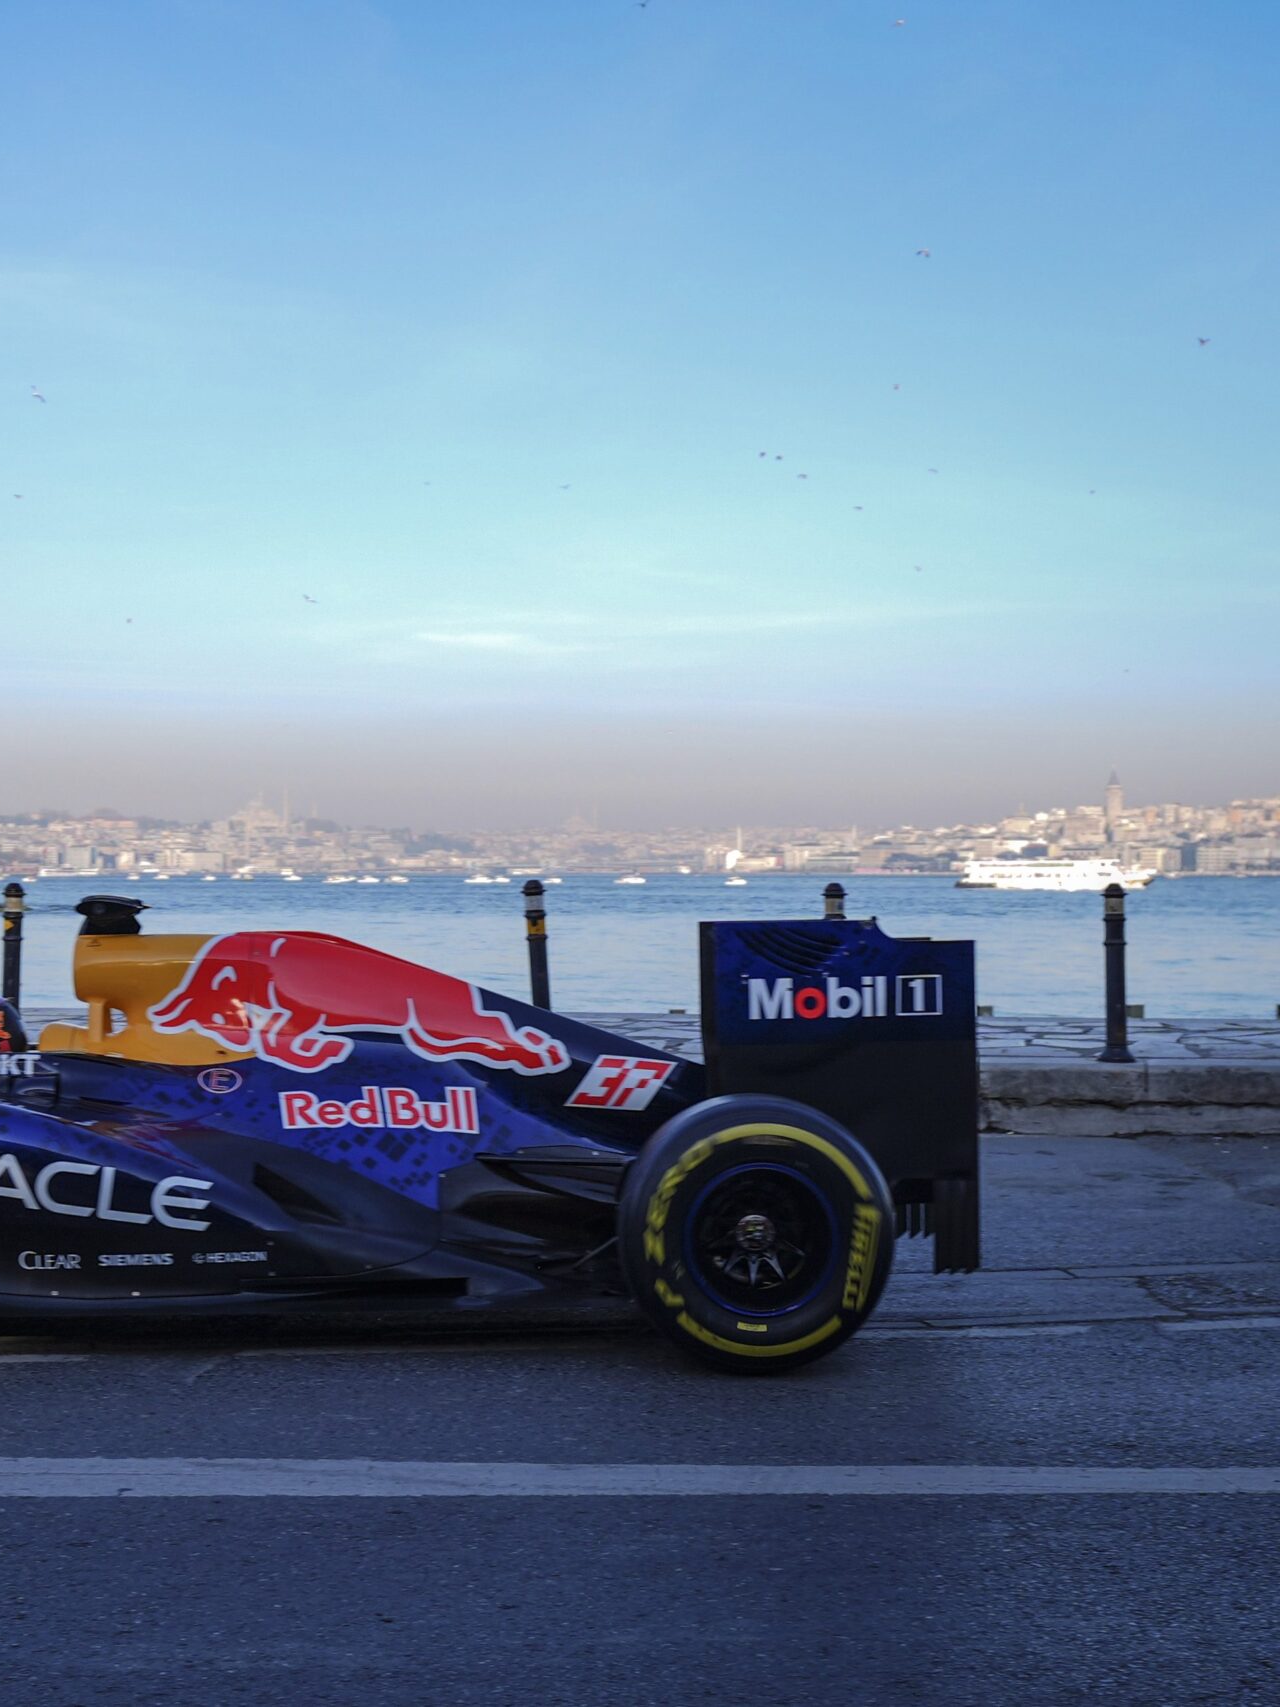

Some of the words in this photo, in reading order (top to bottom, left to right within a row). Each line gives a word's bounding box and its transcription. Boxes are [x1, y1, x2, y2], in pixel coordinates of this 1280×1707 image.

[748, 976, 887, 1020] Mobil
[906, 978, 926, 1012] 1
[280, 1087, 382, 1128] Red
[383, 1087, 478, 1133] Bull
[98, 1253, 175, 1267] SIEMENS
[655, 1279, 684, 1307] P
